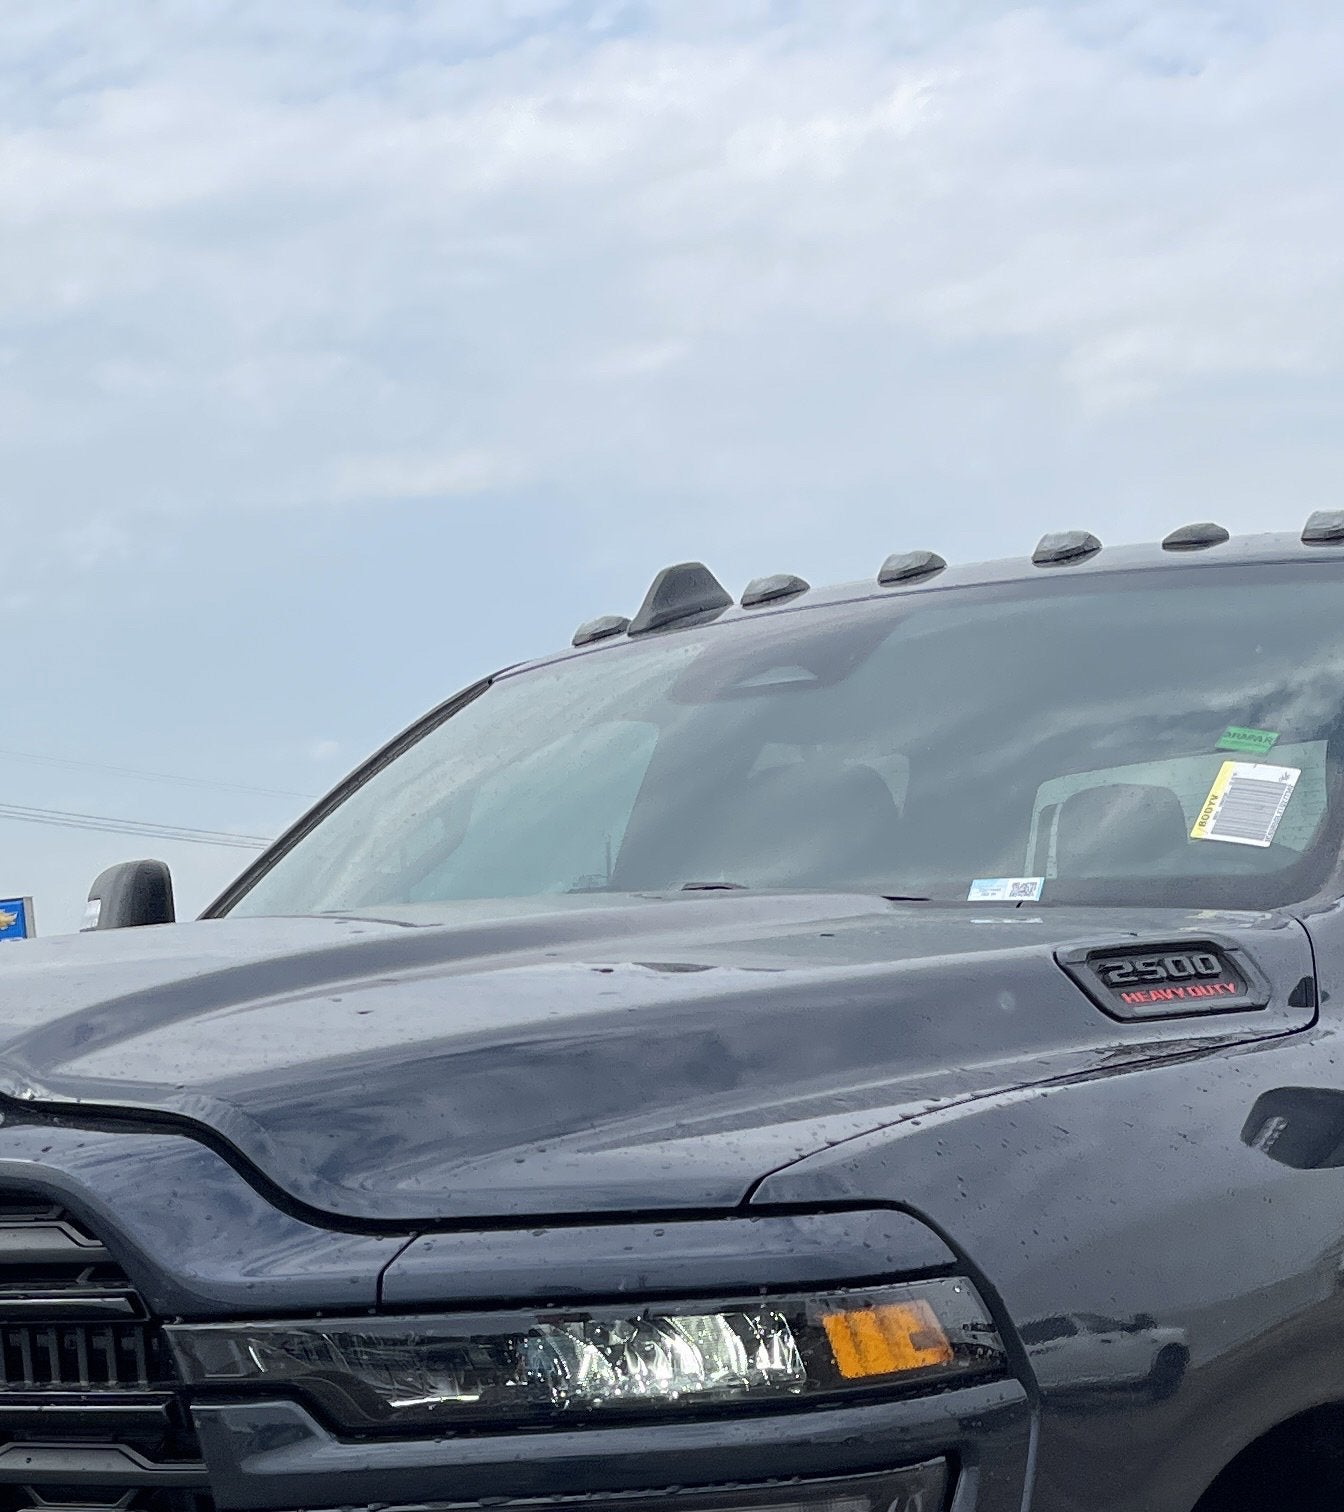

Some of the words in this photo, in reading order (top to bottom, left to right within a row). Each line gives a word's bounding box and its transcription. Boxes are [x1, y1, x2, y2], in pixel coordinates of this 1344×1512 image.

[1105, 953, 1223, 988] 2500
[1120, 985, 1185, 1004] HEAVY
[1186, 982, 1236, 997] DUTY
